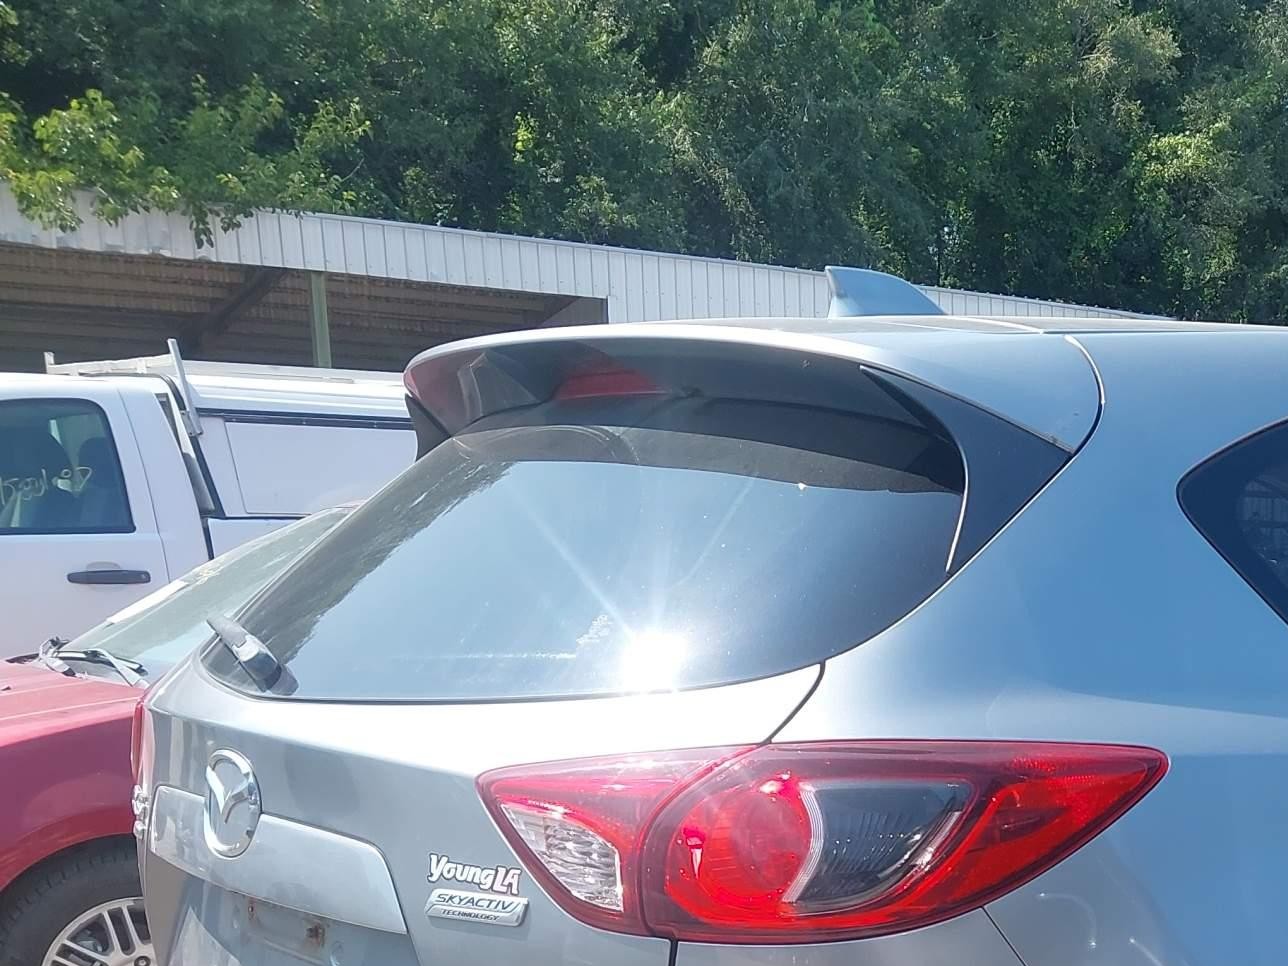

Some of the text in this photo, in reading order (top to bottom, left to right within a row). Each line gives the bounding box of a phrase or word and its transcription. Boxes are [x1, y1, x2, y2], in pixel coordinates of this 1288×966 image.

[427, 853, 522, 895] YoungLA
[435, 894, 514, 911] SKYACTIV
[441, 909, 500, 921] TECHNOLOGY
